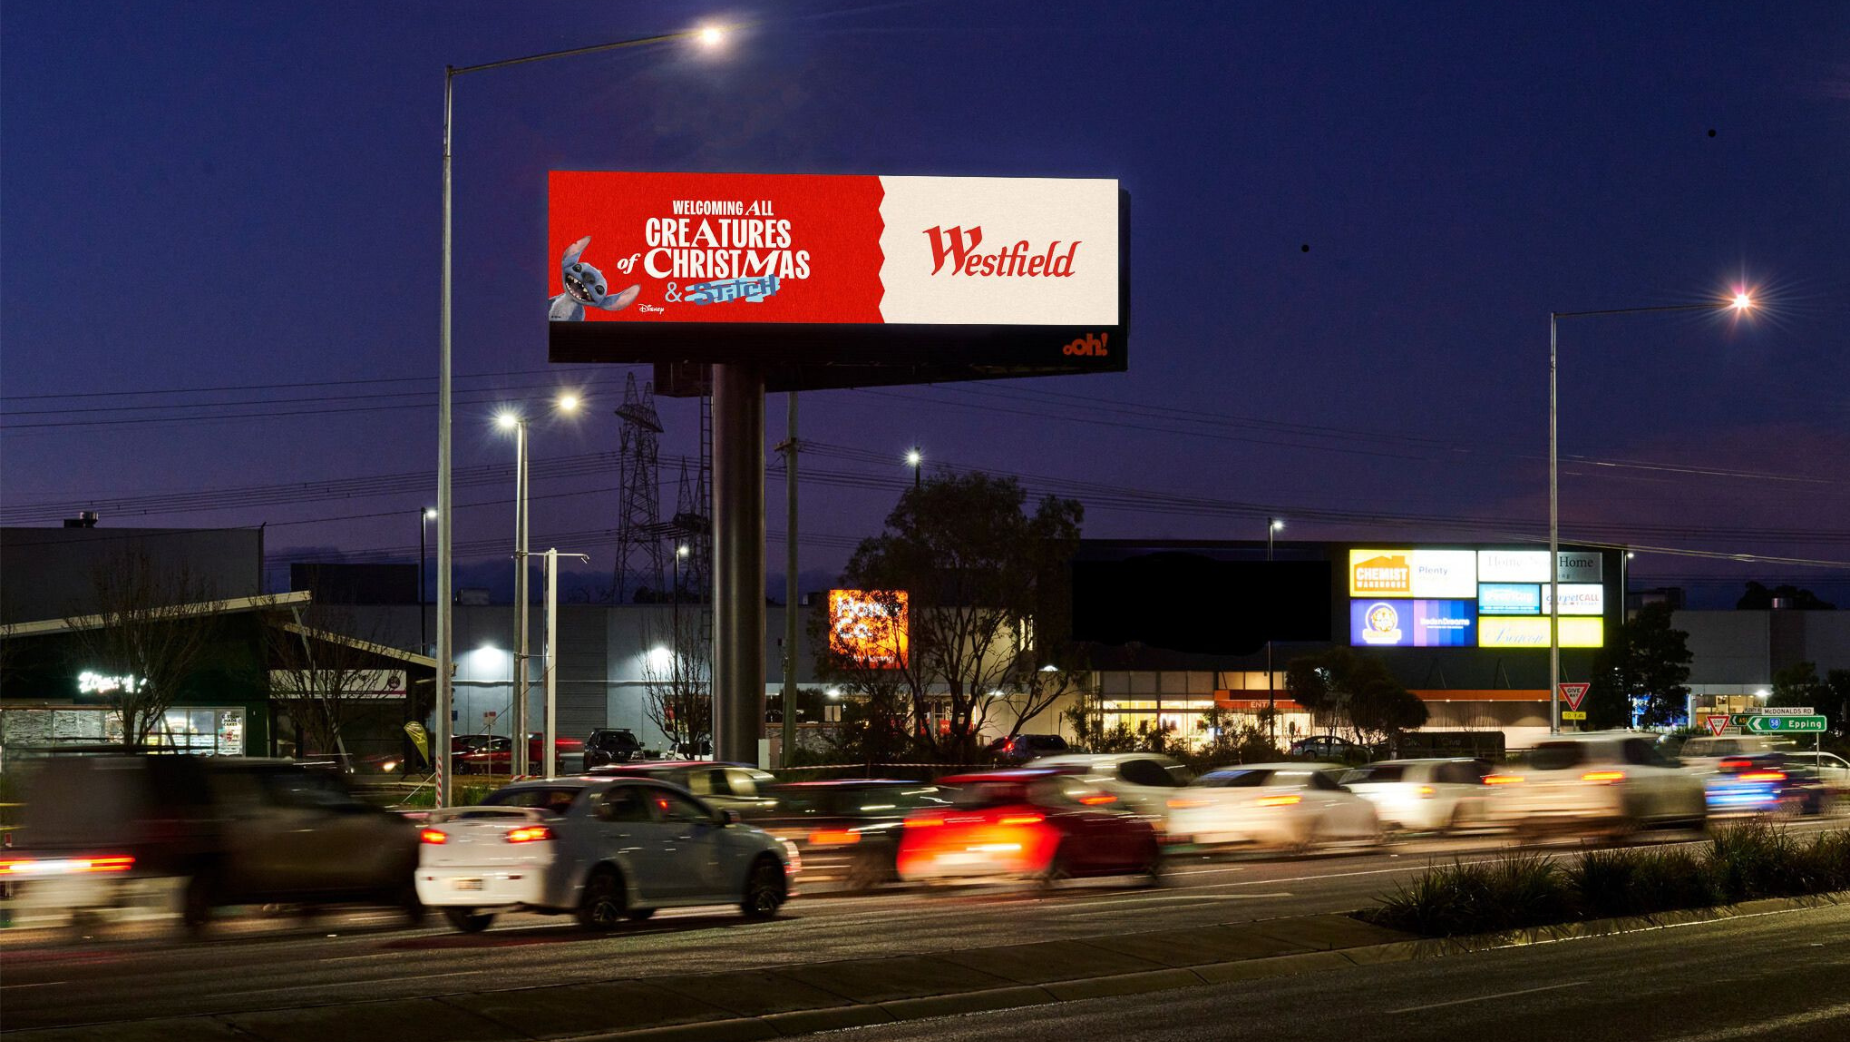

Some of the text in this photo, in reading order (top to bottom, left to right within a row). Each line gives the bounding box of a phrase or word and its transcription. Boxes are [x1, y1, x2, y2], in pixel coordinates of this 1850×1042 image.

[672, 200, 774, 216] WELCOMING ALL
[645, 217, 792, 248] CREATURES
[922, 225, 1083, 278] Westfield
[616, 248, 811, 279] of CHRISTMAS
[664, 281, 682, 302] &
[638, 303, 665, 315] Disney
[1559, 556, 1594, 568] Home
[1356, 567, 1408, 580] CHEMIST
[1418, 566, 1448, 575] Plenty
[1770, 719, 1822, 730] 58 Epping
